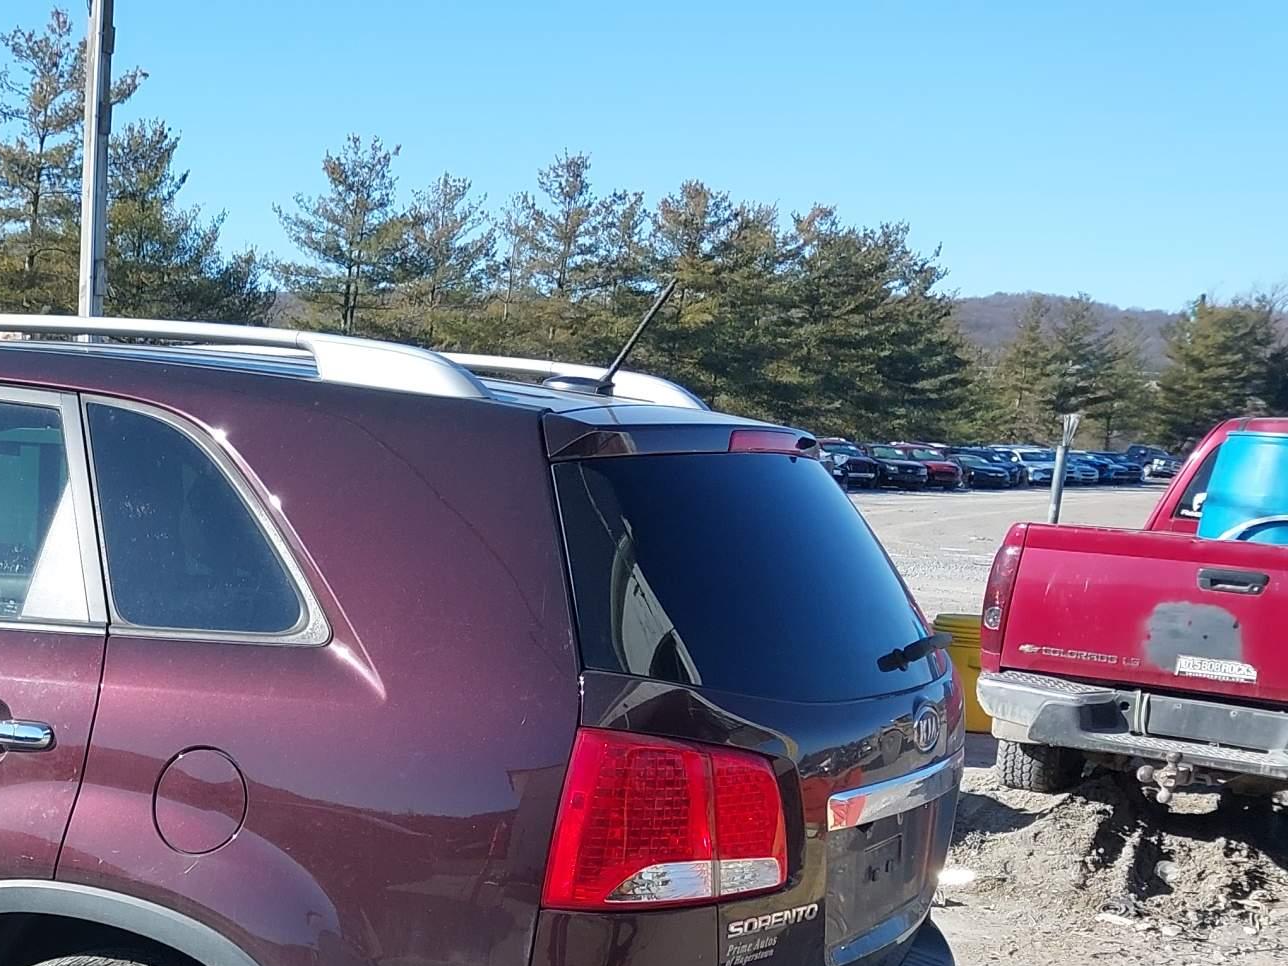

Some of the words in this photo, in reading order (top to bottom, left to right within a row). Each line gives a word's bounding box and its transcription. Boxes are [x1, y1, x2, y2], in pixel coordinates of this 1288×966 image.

[1042, 646, 1118, 664] COLORADO
[727, 903, 819, 939] SORENTO
[726, 941, 752, 957] Prime
[752, 936, 778, 951] Autos
